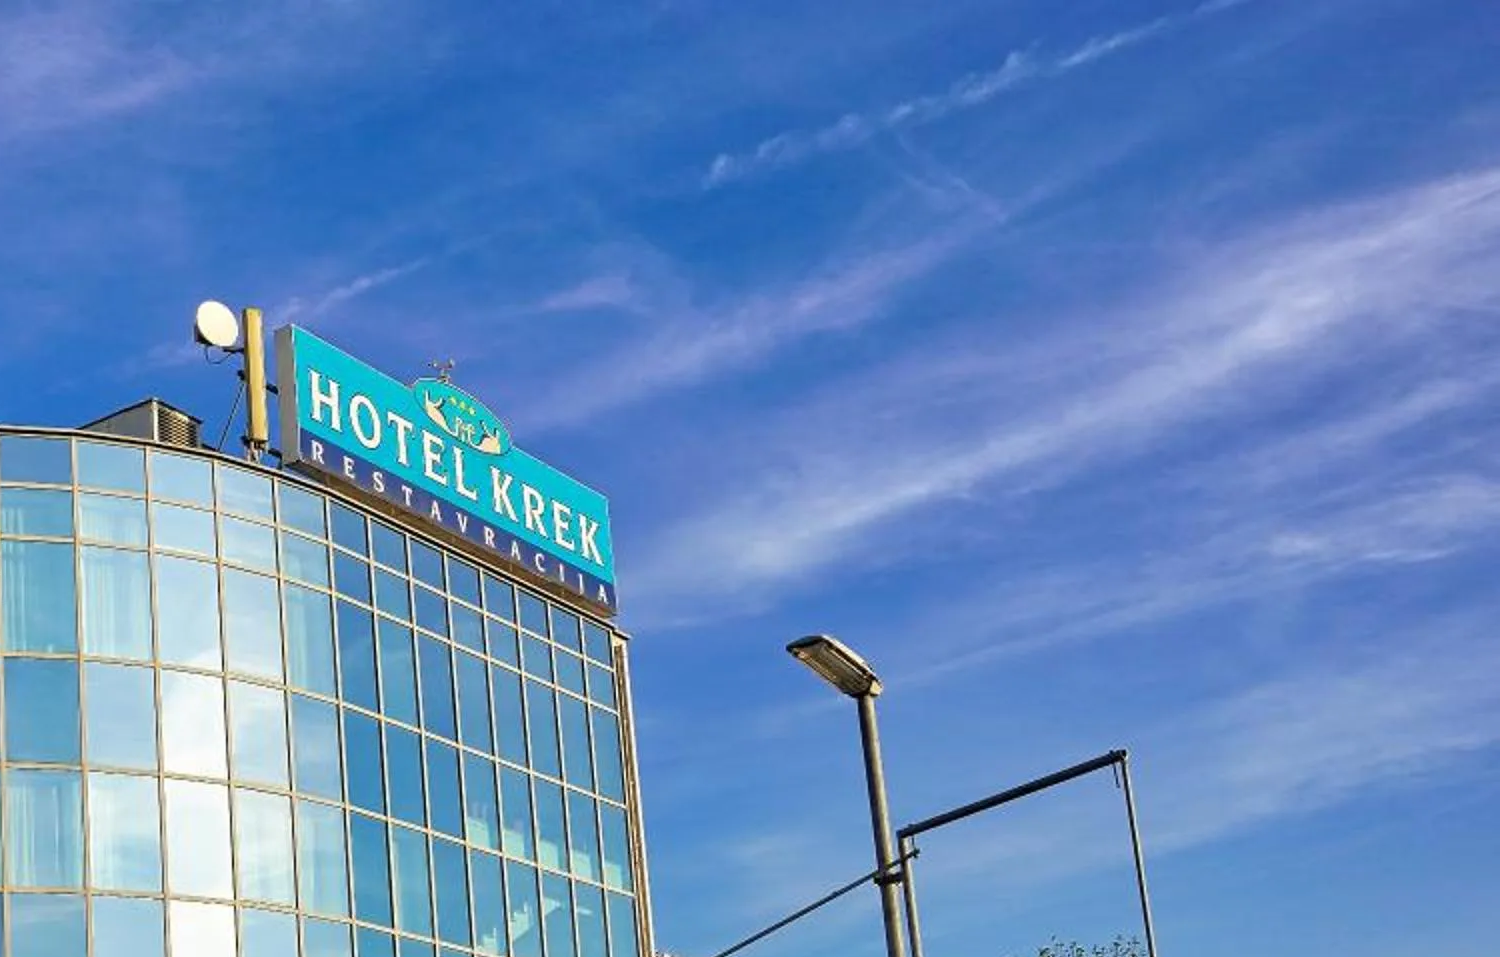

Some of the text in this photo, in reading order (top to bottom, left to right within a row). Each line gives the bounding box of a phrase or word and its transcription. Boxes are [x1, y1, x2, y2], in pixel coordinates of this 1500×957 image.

[308, 367, 605, 567] HOTEL KREK
[310, 439, 608, 603] RESTAVRACIJA
